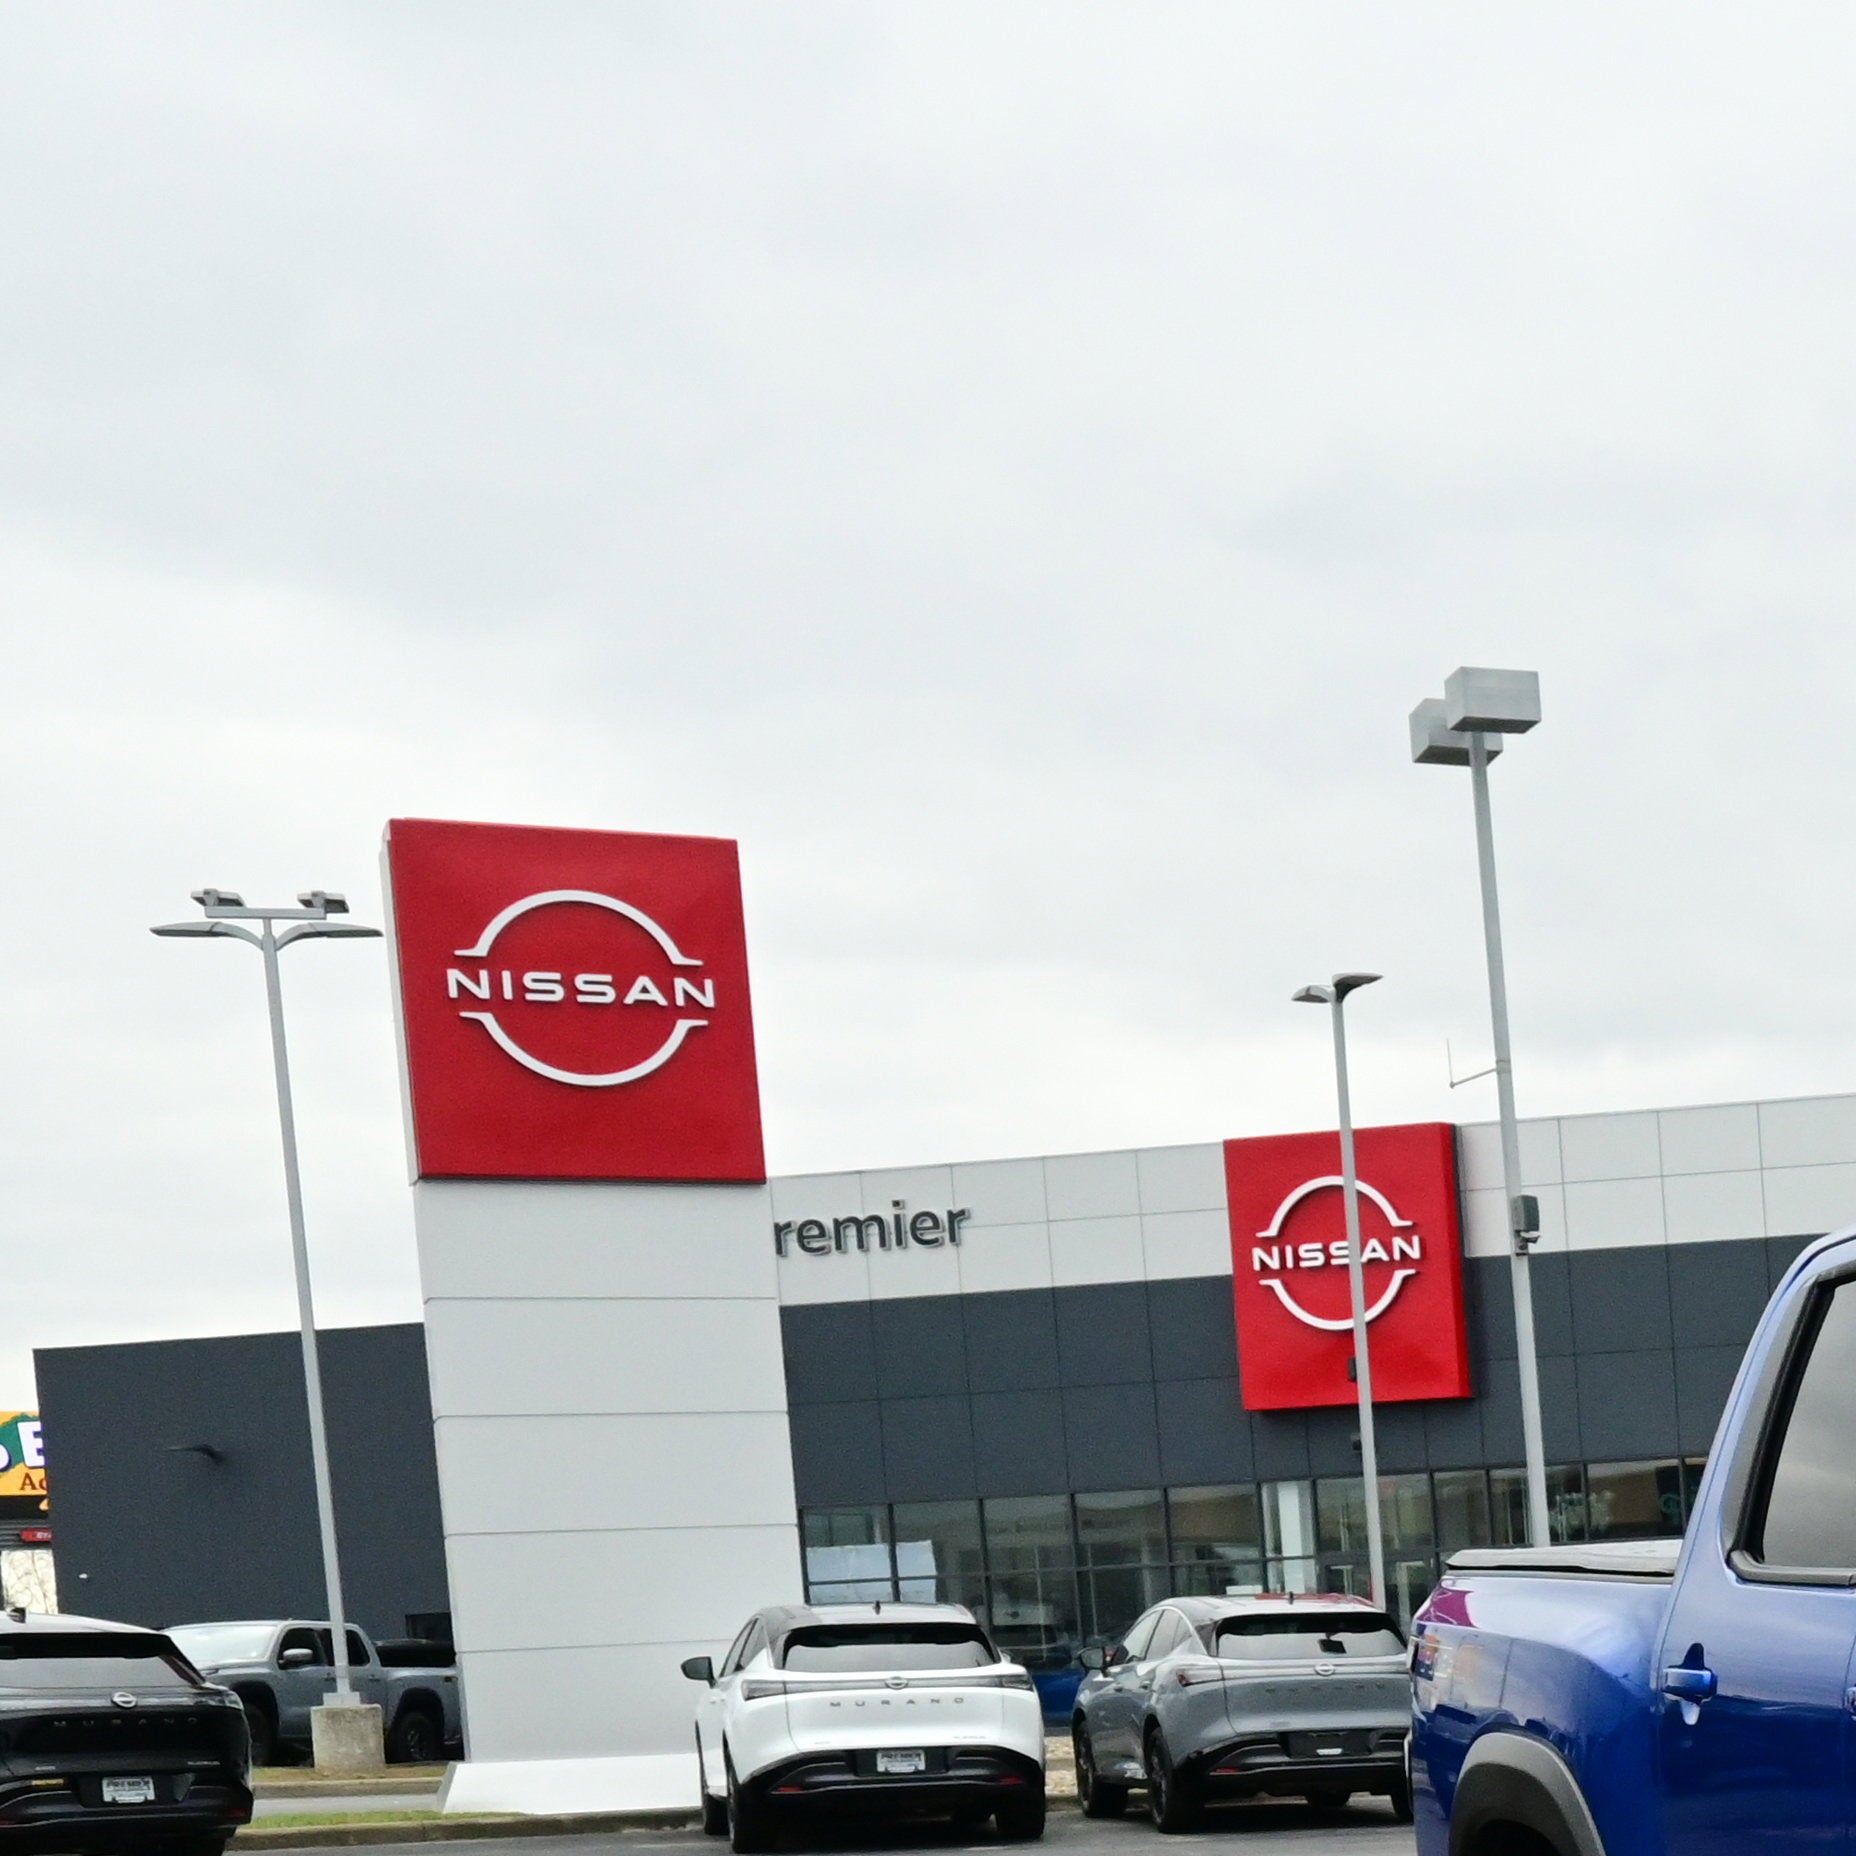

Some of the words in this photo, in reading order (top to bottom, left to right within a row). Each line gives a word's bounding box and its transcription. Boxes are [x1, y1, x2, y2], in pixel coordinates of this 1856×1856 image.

[446, 967, 716, 1009] NISSAN
[773, 1199, 971, 1257] remier
[1251, 1234, 1422, 1272] NISSAN
[830, 1696, 965, 1708] MURANO
